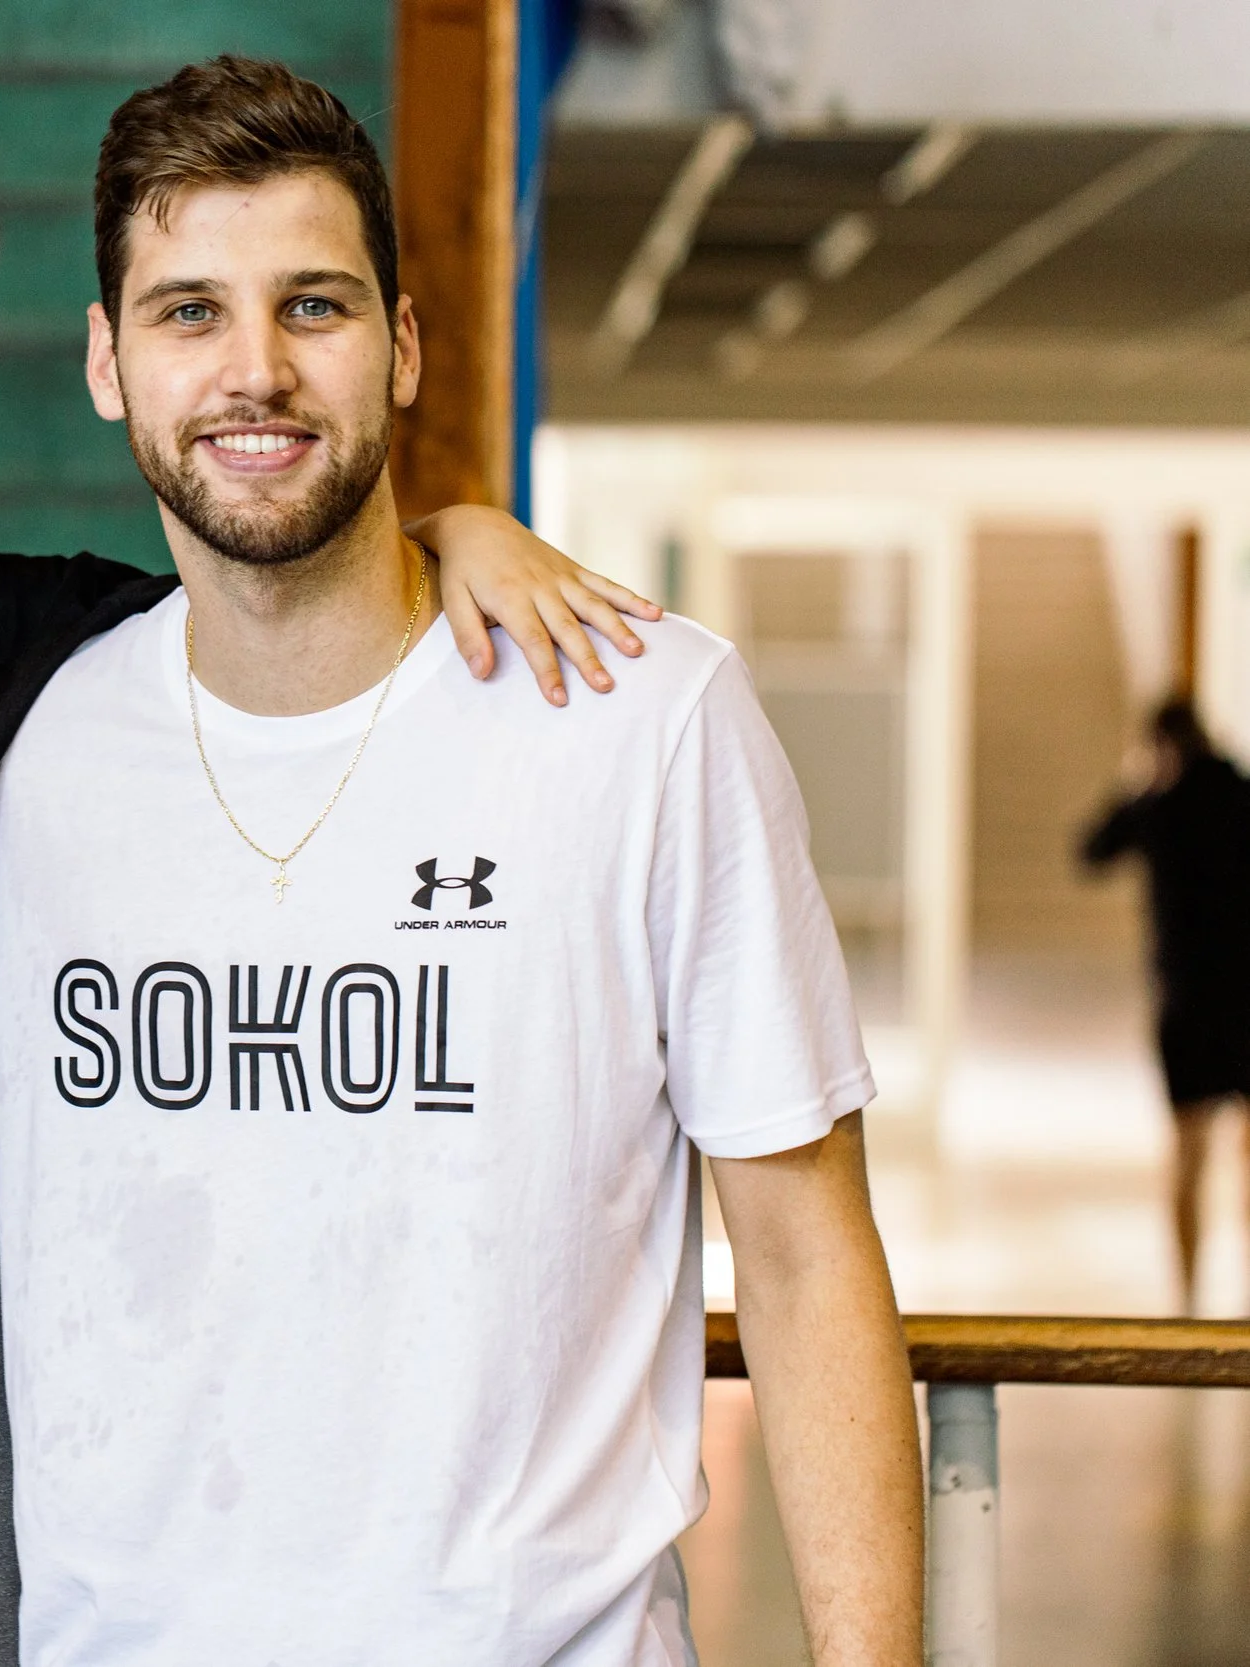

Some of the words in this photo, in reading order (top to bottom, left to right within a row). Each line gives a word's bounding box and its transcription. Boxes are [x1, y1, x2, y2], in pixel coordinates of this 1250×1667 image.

[394, 921, 439, 930] UNDER
[444, 920, 507, 930] ARMOUR
[53, 958, 474, 1114] SOKOL
